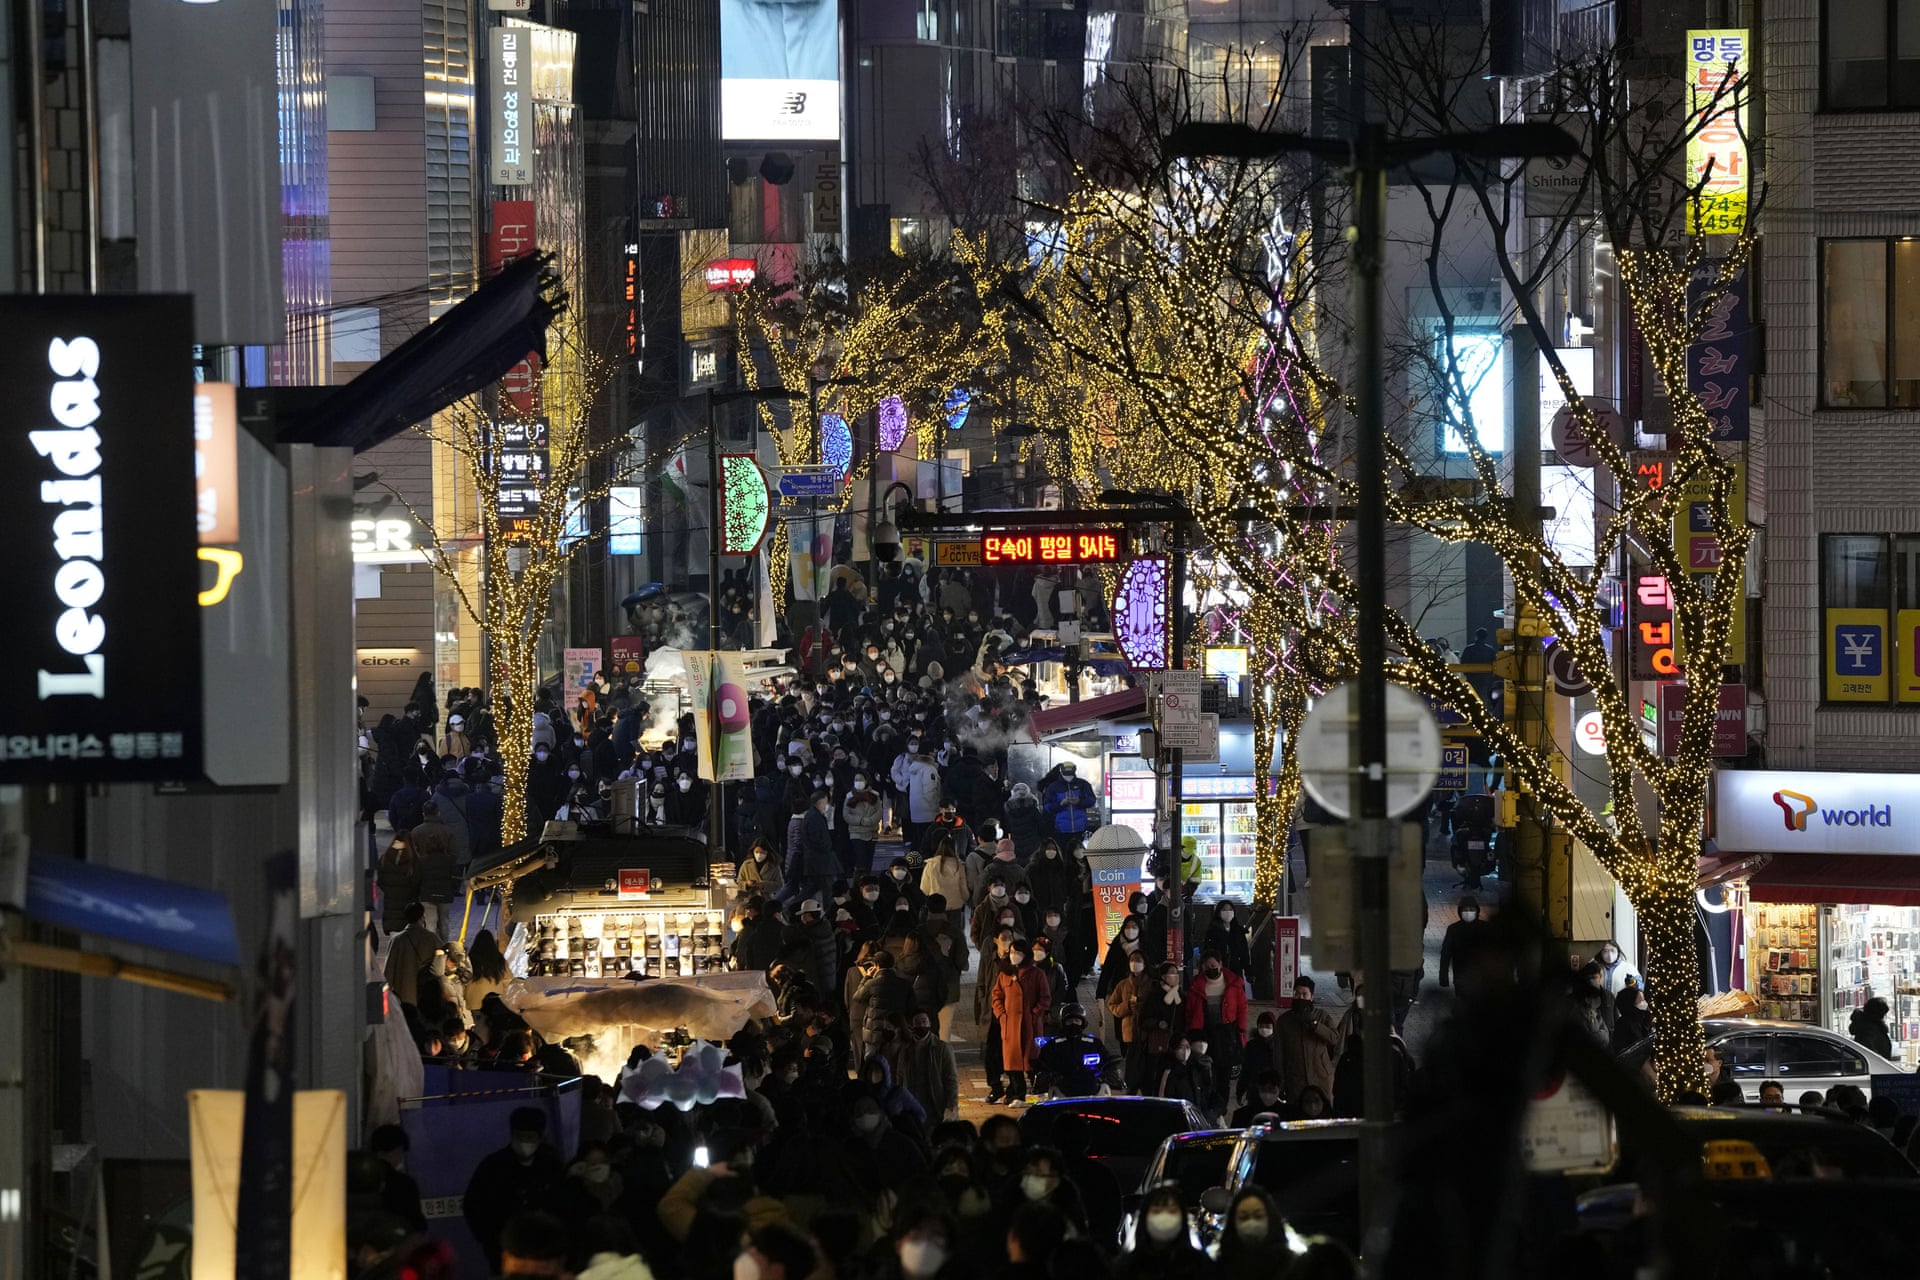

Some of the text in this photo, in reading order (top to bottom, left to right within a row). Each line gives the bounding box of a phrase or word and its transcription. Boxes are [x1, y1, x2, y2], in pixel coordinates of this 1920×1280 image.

[1692, 37, 1743, 62] 명동
[503, 91, 520, 165] 성형외과
[1695, 67, 1744, 187] 부동산
[28, 336, 106, 700] Leonidas
[985, 537, 1033, 561] 단속이
[1040, 536, 1072, 560] 평일
[1694, 542, 1723, 565] 元
[362, 655, 410, 666] EIDER
[1841, 633, 1875, 667] ¥
[1842, 683, 1873, 694] 고래환전
[1113, 784, 1140, 797] SIM
[1822, 804, 1892, 827] world
[1098, 870, 1125, 881] Coin
[1099, 886, 1127, 904] 씽씽
